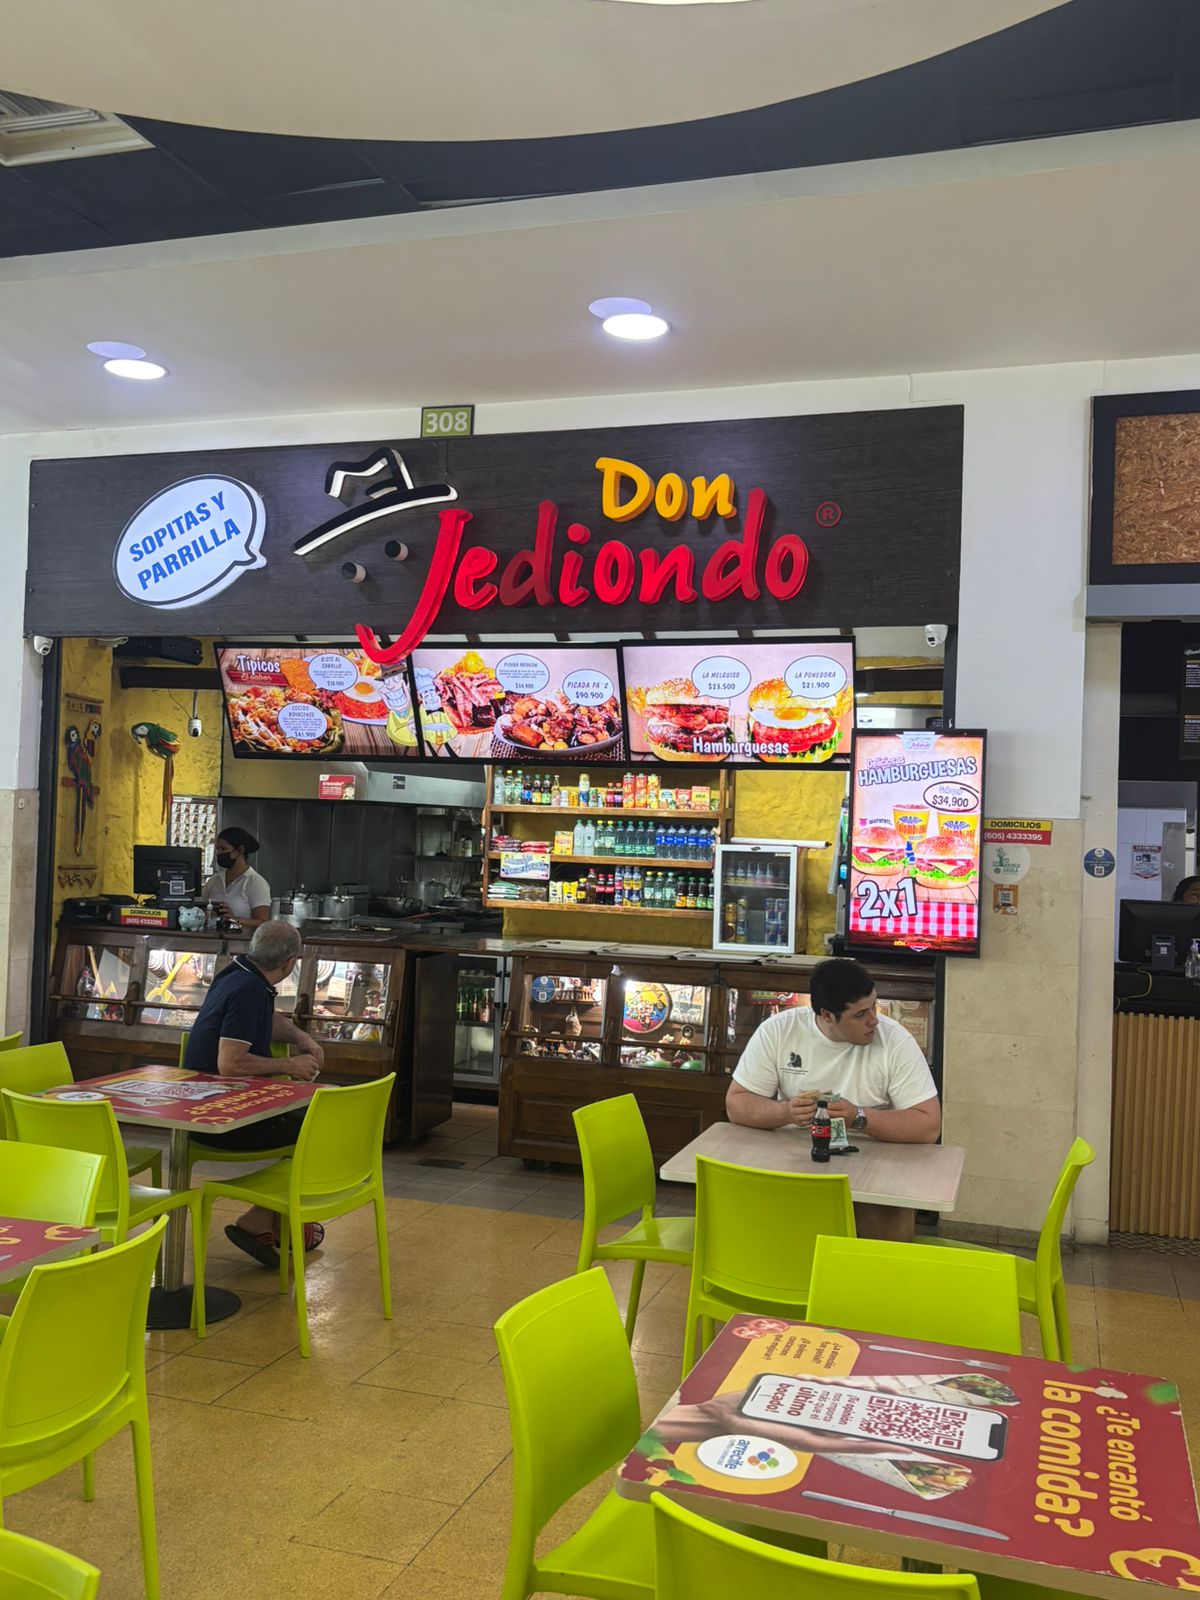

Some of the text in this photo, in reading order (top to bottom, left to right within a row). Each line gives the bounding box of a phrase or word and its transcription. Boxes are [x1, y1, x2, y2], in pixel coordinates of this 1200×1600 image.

[426, 411, 468, 433] 308
[595, 456, 738, 523] Don
[129, 491, 229, 563] SOPITAS Y
[137, 517, 242, 591] PARRILLA
[355, 486, 810, 667] Jediondo
[235, 654, 281, 676] Típicos
[702, 671, 710, 679] LA
[794, 671, 836, 679] LA PONEDORA
[567, 681, 590, 689] PICADA
[575, 691, 604, 700] $90.900
[801, 681, 830, 690] $21.900
[692, 736, 790, 759] Hamburguesas
[858, 757, 978, 786] HAMBURGUESAS
[931, 793, 969, 808] $34,900
[984, 831, 1005, 841] (605)
[990, 820, 1042, 829] DOMICILIOS
[857, 876, 919, 919] 2x1
[811, 1347, 825, 1365] genial?
[823, 1350, 838, 1369] atención
[764, 1382, 796, 1414] bocado!
[787, 1386, 819, 1417] último
[810, 1390, 831, 1421] más que el
[823, 1392, 843, 1422] nos importa
[838, 1403, 856, 1425] opinión
[724, 1439, 751, 1470] arrecife
[1033, 1378, 1101, 1538] la comida?
[1096, 1405, 1154, 1522] ¿Te encantó
